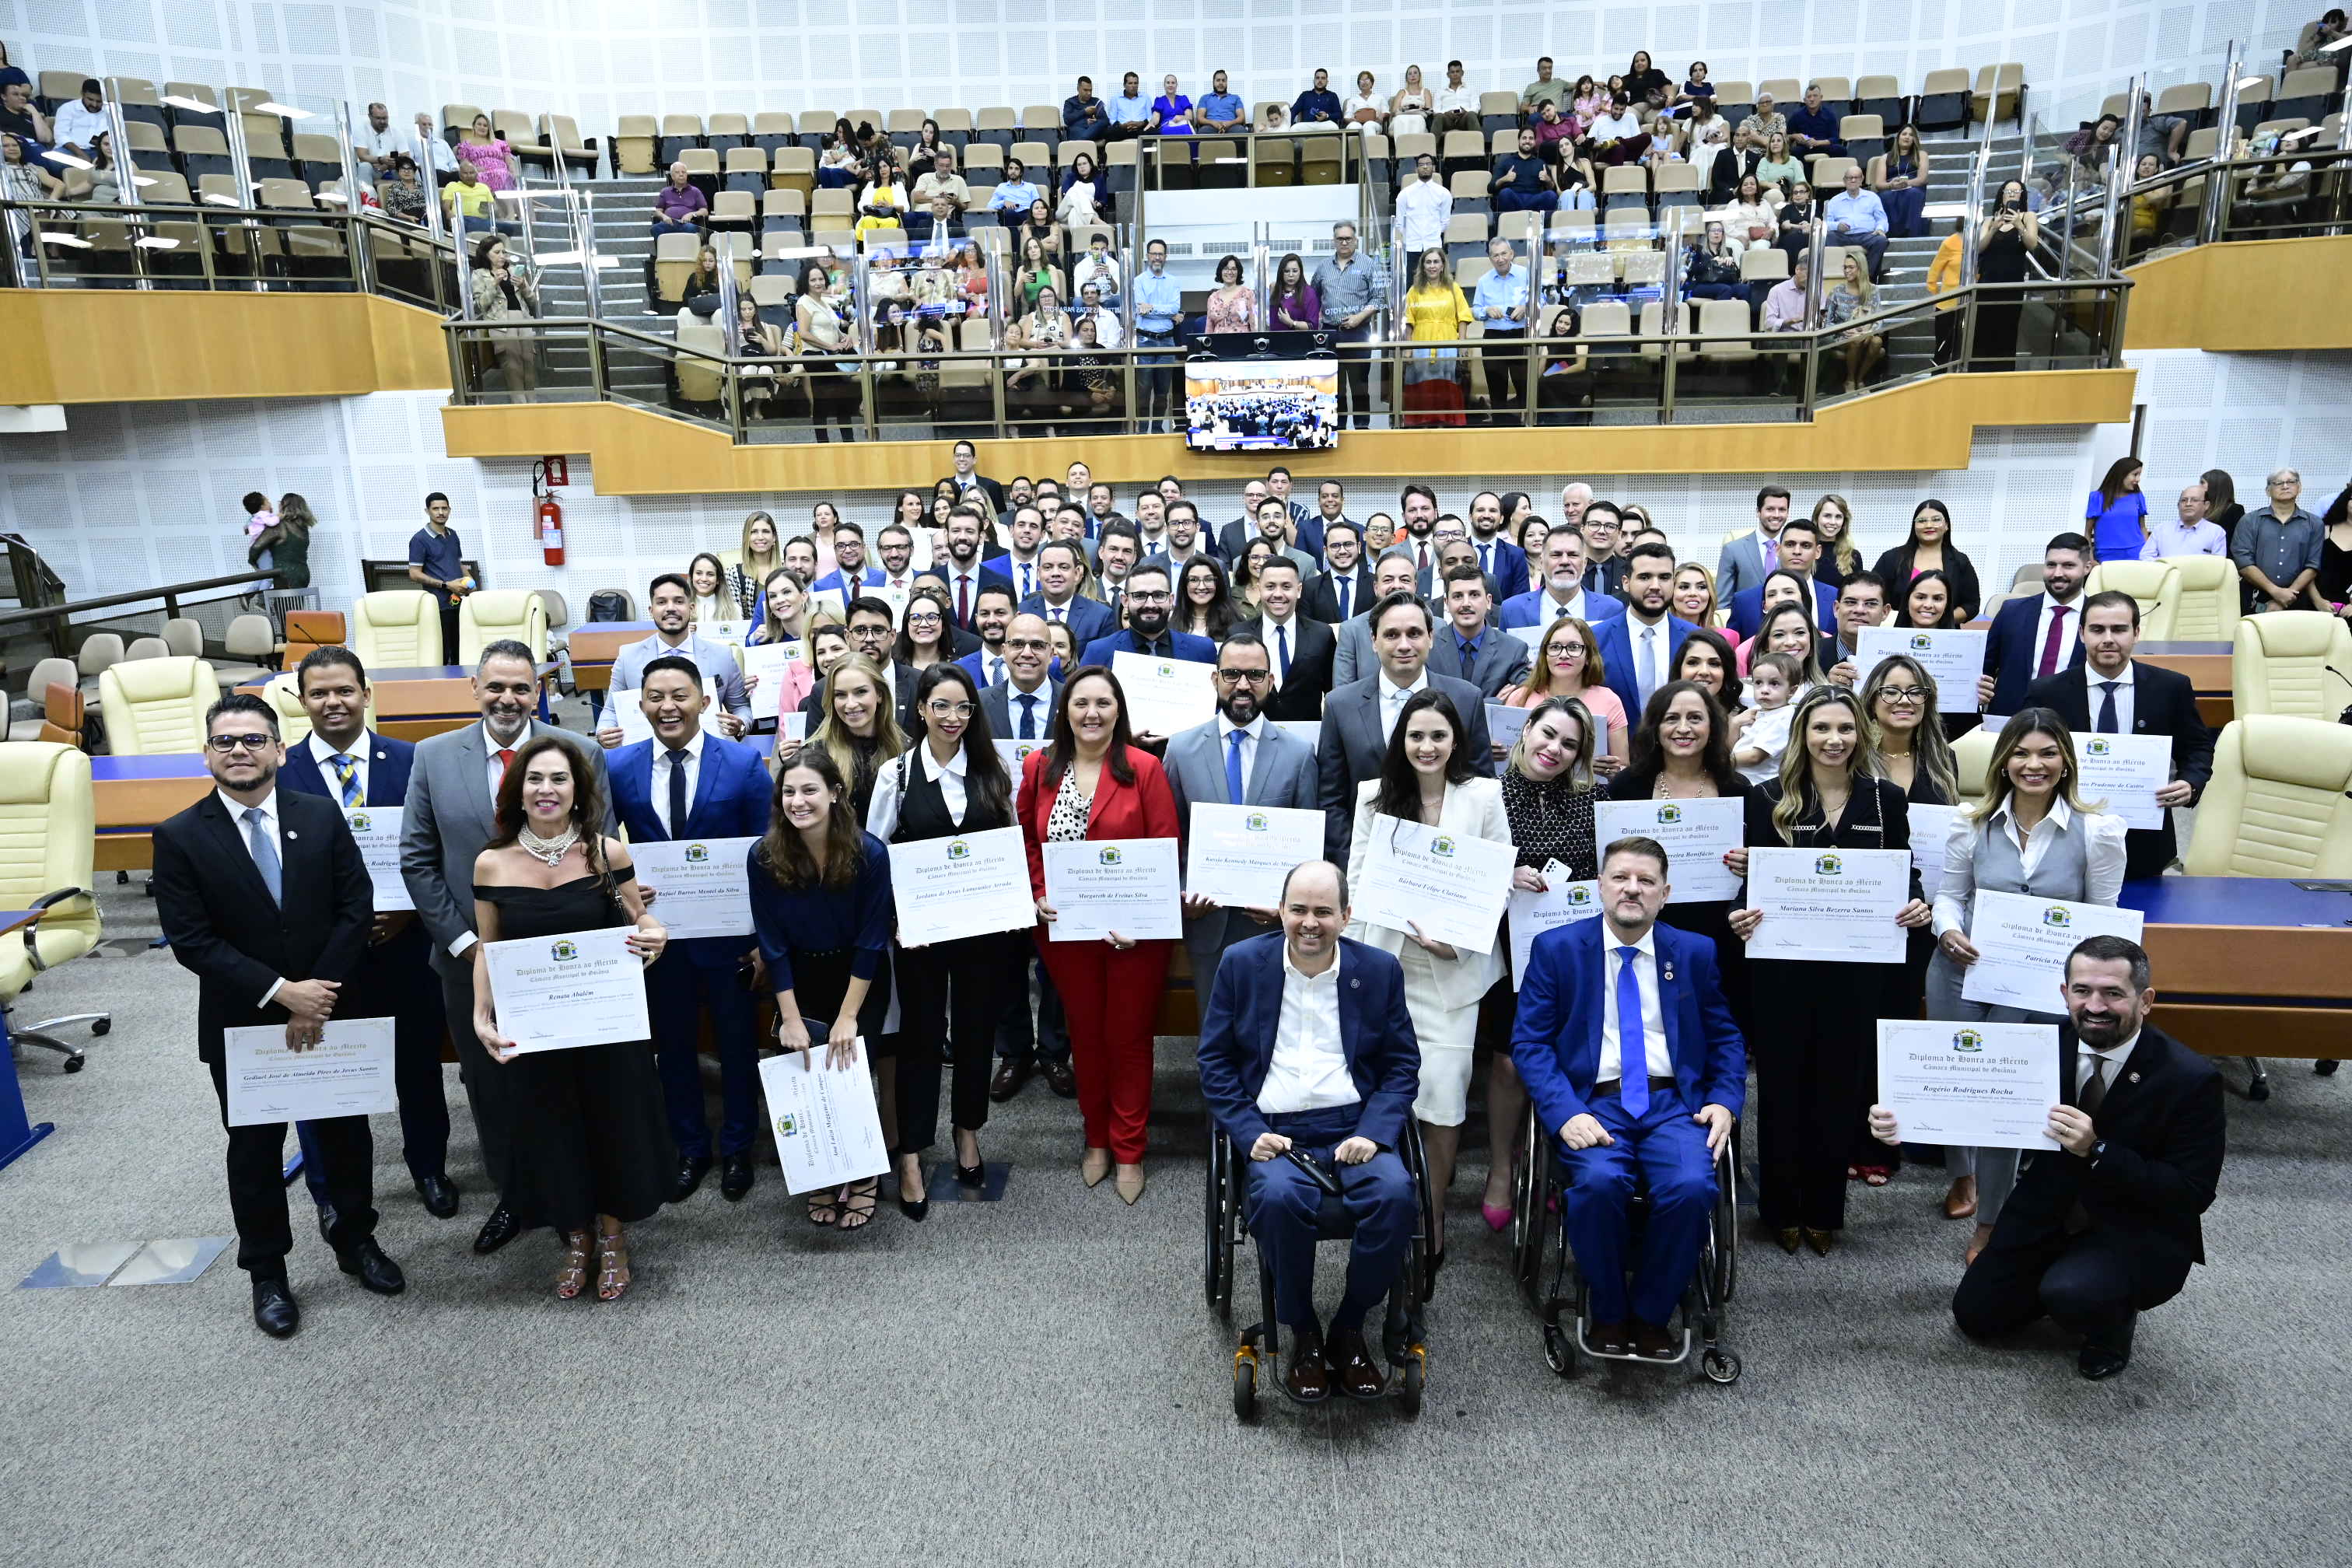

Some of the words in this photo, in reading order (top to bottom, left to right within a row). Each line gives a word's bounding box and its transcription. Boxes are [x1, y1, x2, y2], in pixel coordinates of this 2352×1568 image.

[1774, 877, 1806, 885] Diploma
[915, 892, 936, 901] Jordana
[516, 966, 546, 978] Diploma
[571, 989, 593, 998] Abalém
[1909, 1053, 1944, 1062] Diploma
[1947, 1054, 1955, 1062] de
[1999, 1056, 2028, 1066] Mérito
[1923, 1085, 1951, 1094] Rogério
[1953, 1087, 1988, 1095] Rodrigues
